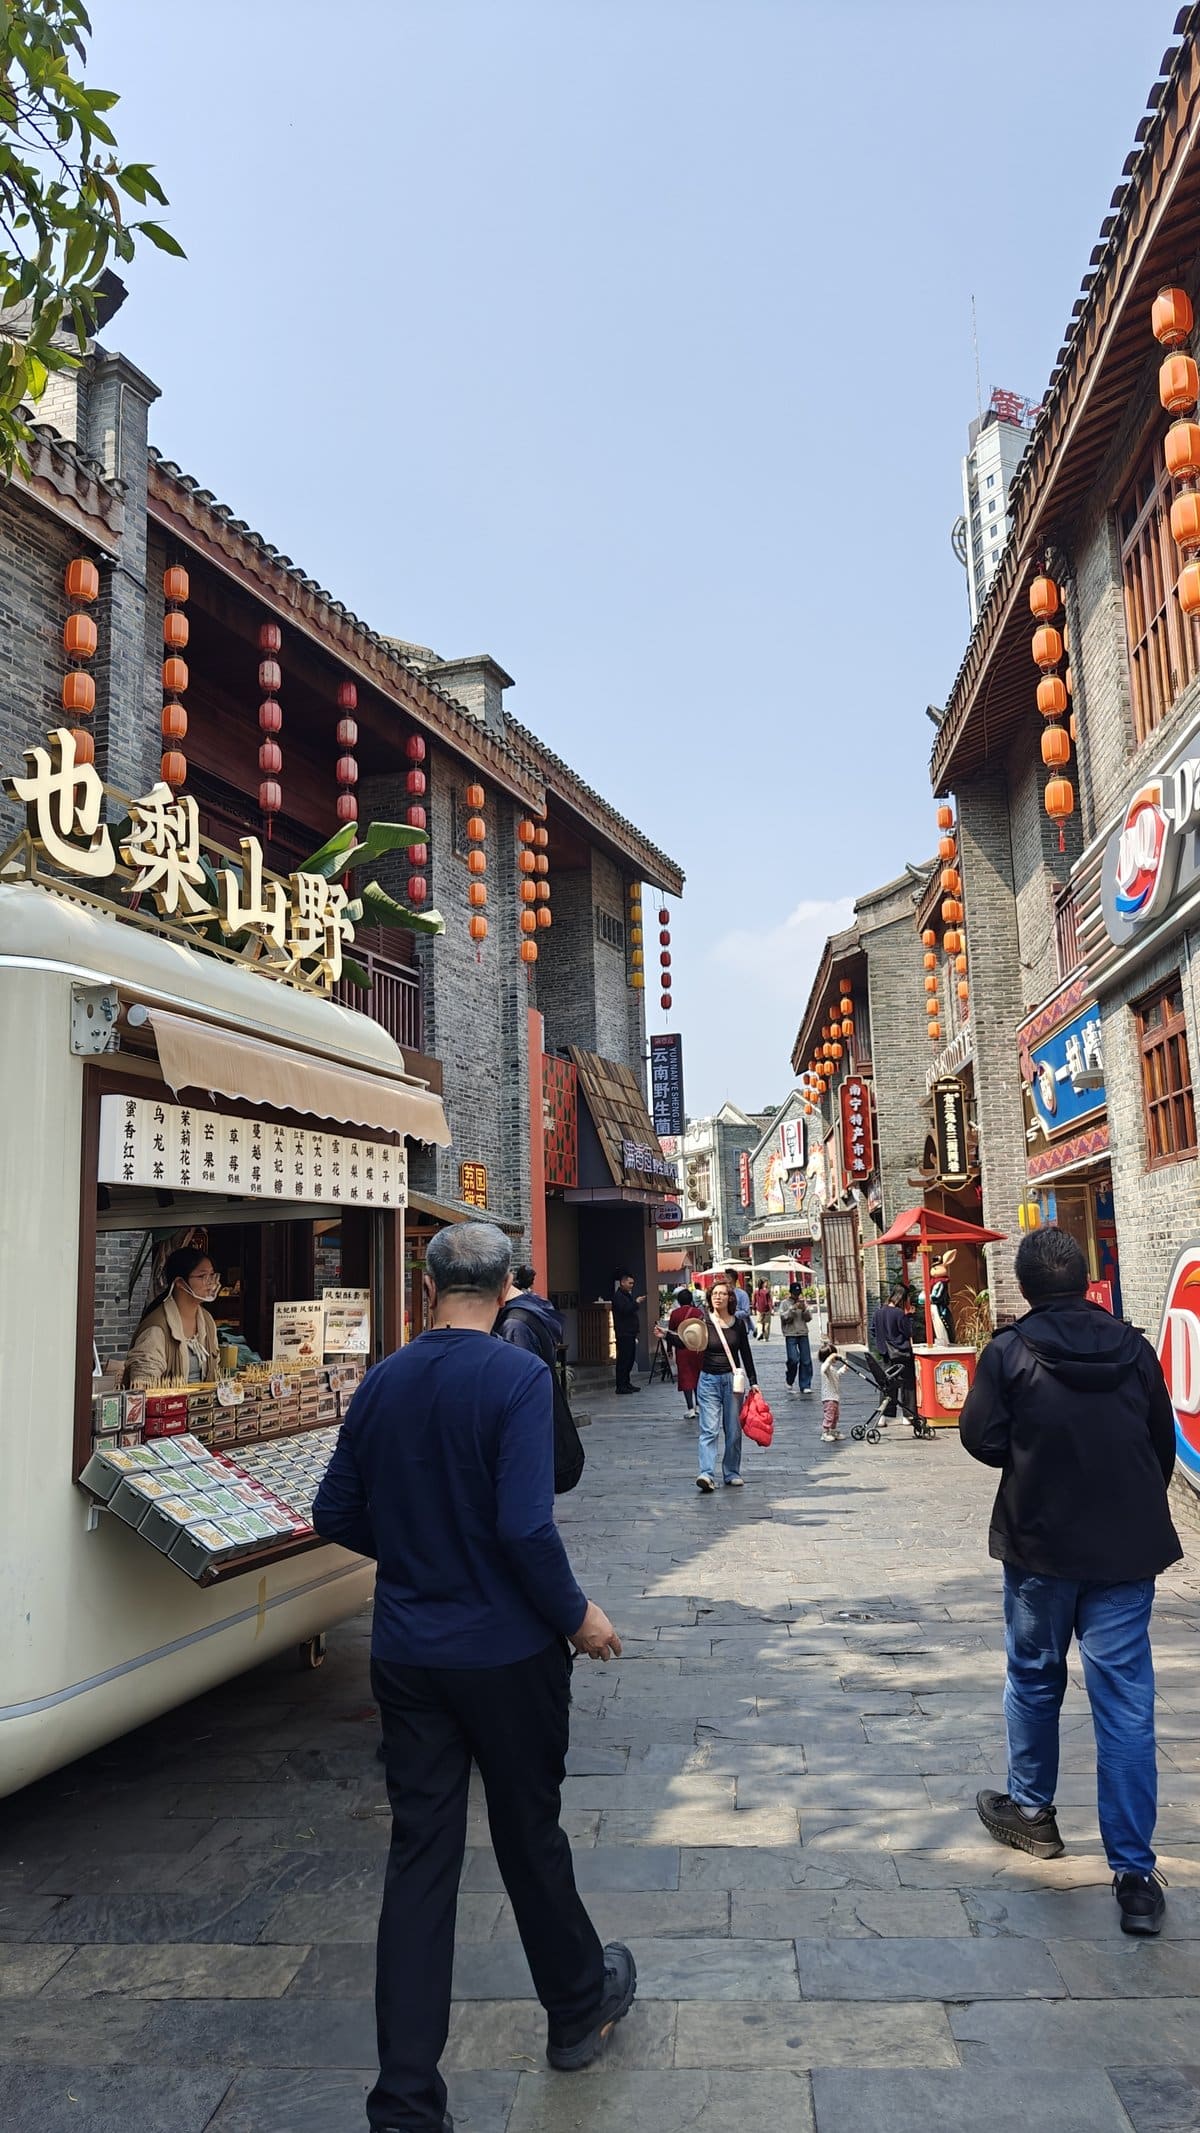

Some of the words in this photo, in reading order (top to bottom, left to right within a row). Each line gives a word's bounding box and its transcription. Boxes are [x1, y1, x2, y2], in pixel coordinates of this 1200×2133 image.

[1172, 758, 1200, 834] D
[2, 727, 355, 982] 也梨山野
[652, 1047, 671, 1135] 云南野生菌
[123, 1100, 137, 1181] 蜜香红茶
[153, 1105, 165, 1180] 乌龙茶
[180, 1110, 191, 1185] 茉莉花茶
[203, 1123, 215, 1168] 芒果
[228, 1129, 239, 1172] 草莓
[251, 1123, 262, 1182] 蔓越莓
[849, 1083, 865, 1171] 南宁特产市集
[331, 1139, 341, 1198] 雪花酥
[350, 1143, 359, 1200] 凤梨酥
[366, 1146, 374, 1201] 蝴蝶酥
[382, 1149, 390, 1203] 梨子酥
[398, 1152, 406, 1204] 凤凰酥
[787, 1247, 802, 1258] KFC
[1168, 1308, 1200, 1415] D
